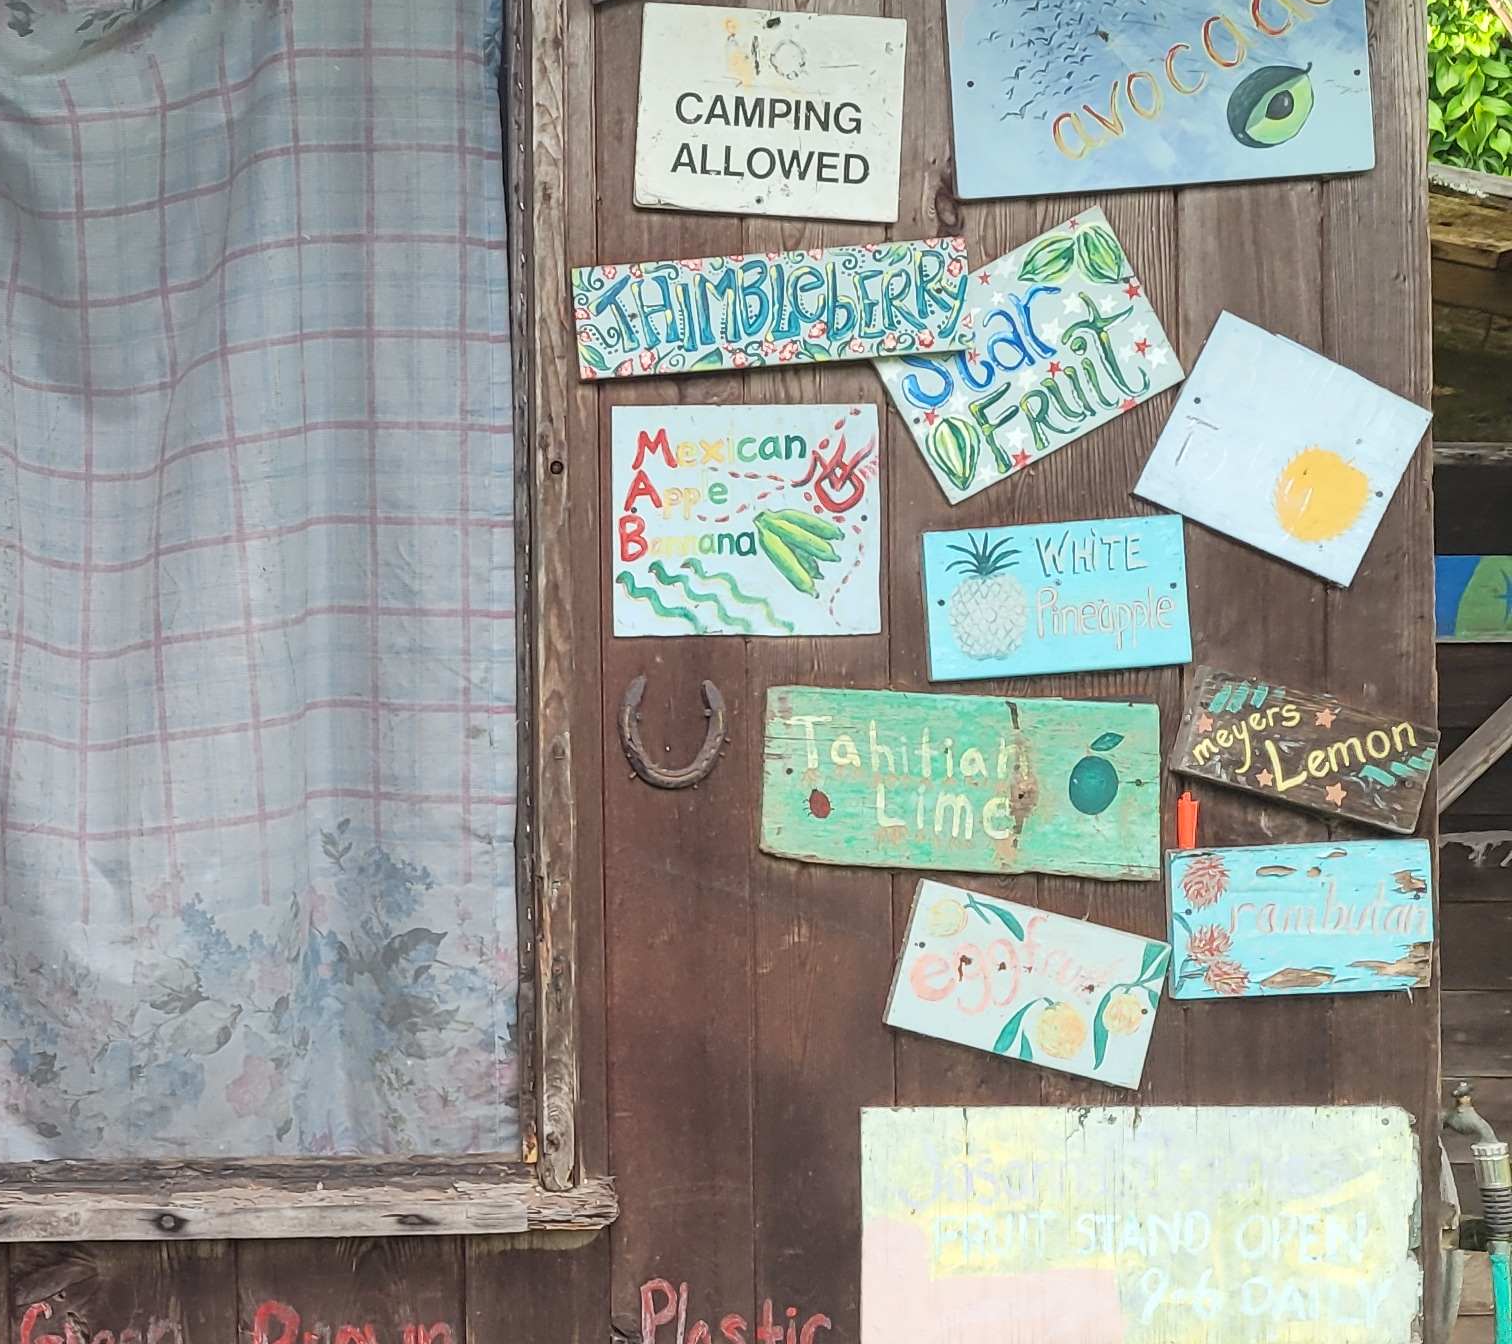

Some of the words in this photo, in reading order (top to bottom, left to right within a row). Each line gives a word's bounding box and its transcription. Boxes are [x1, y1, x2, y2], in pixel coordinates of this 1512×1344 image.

[675, 91, 863, 135] CAMPING
[670, 142, 870, 185] ALLOWED
[631, 428, 808, 471] Mexican
[1033, 584, 1176, 651] Pineapple
[786, 714, 1031, 781] Tahitian
[1191, 702, 1302, 775] meyers
[1264, 720, 1419, 793] Lemon
[874, 782, 1014, 840] Lime
[930, 1209, 1063, 1264] FRUIT
[1073, 1208, 1215, 1258] STAND
[1233, 1209, 1372, 1264] OPEN
[1240, 1273, 1392, 1330] DAILY
